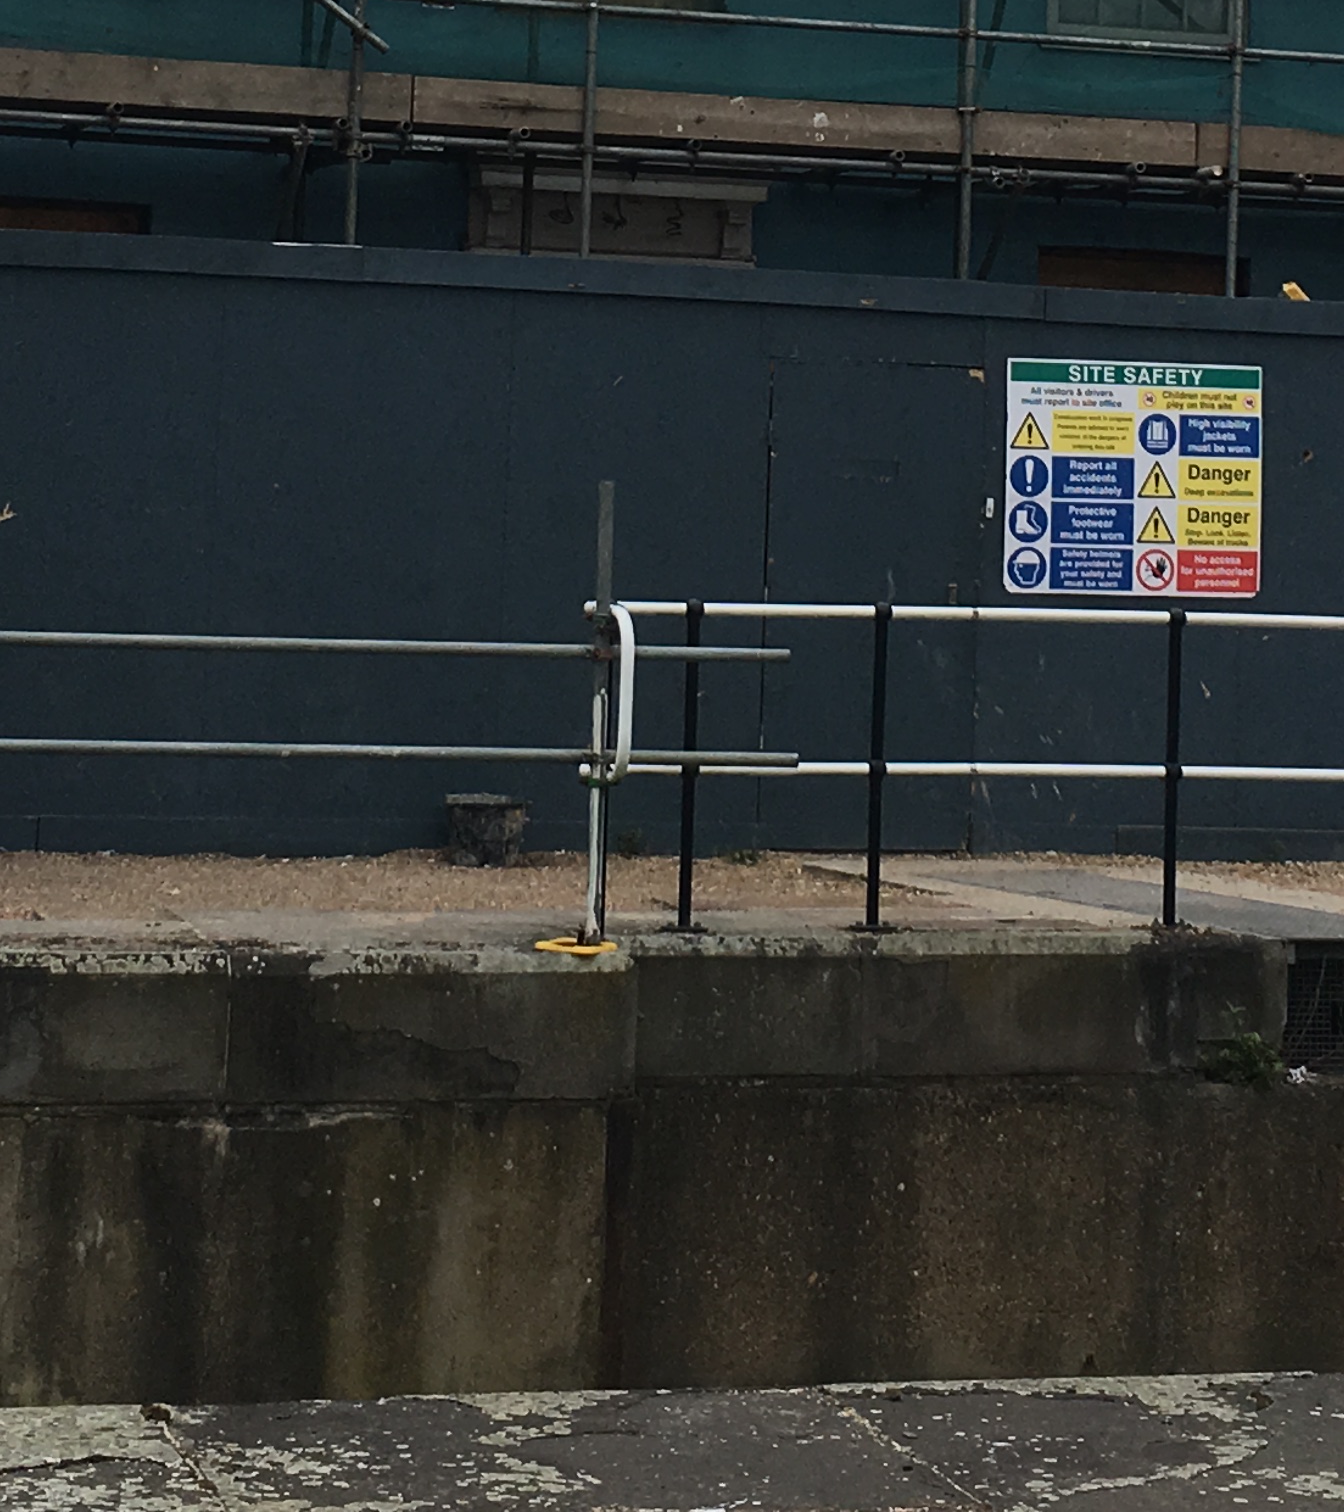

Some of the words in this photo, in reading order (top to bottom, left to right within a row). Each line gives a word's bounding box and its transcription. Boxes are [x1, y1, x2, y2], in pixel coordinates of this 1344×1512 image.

[1068, 365, 1115, 382] SITE
[1123, 367, 1203, 386] SAFETY
[1188, 418, 1211, 431] High
[1187, 443, 1212, 453] must
[1213, 443, 1226, 453] be
[1227, 444, 1252, 454] worn
[1069, 460, 1103, 472] Report
[1069, 473, 1117, 483] accidents
[1188, 464, 1251, 485] Danger
[1187, 507, 1251, 528] Danger
[1060, 530, 1084, 540] must
[1085, 530, 1098, 541] be
[1100, 532, 1125, 541] worn
[1194, 554, 1208, 564] No
